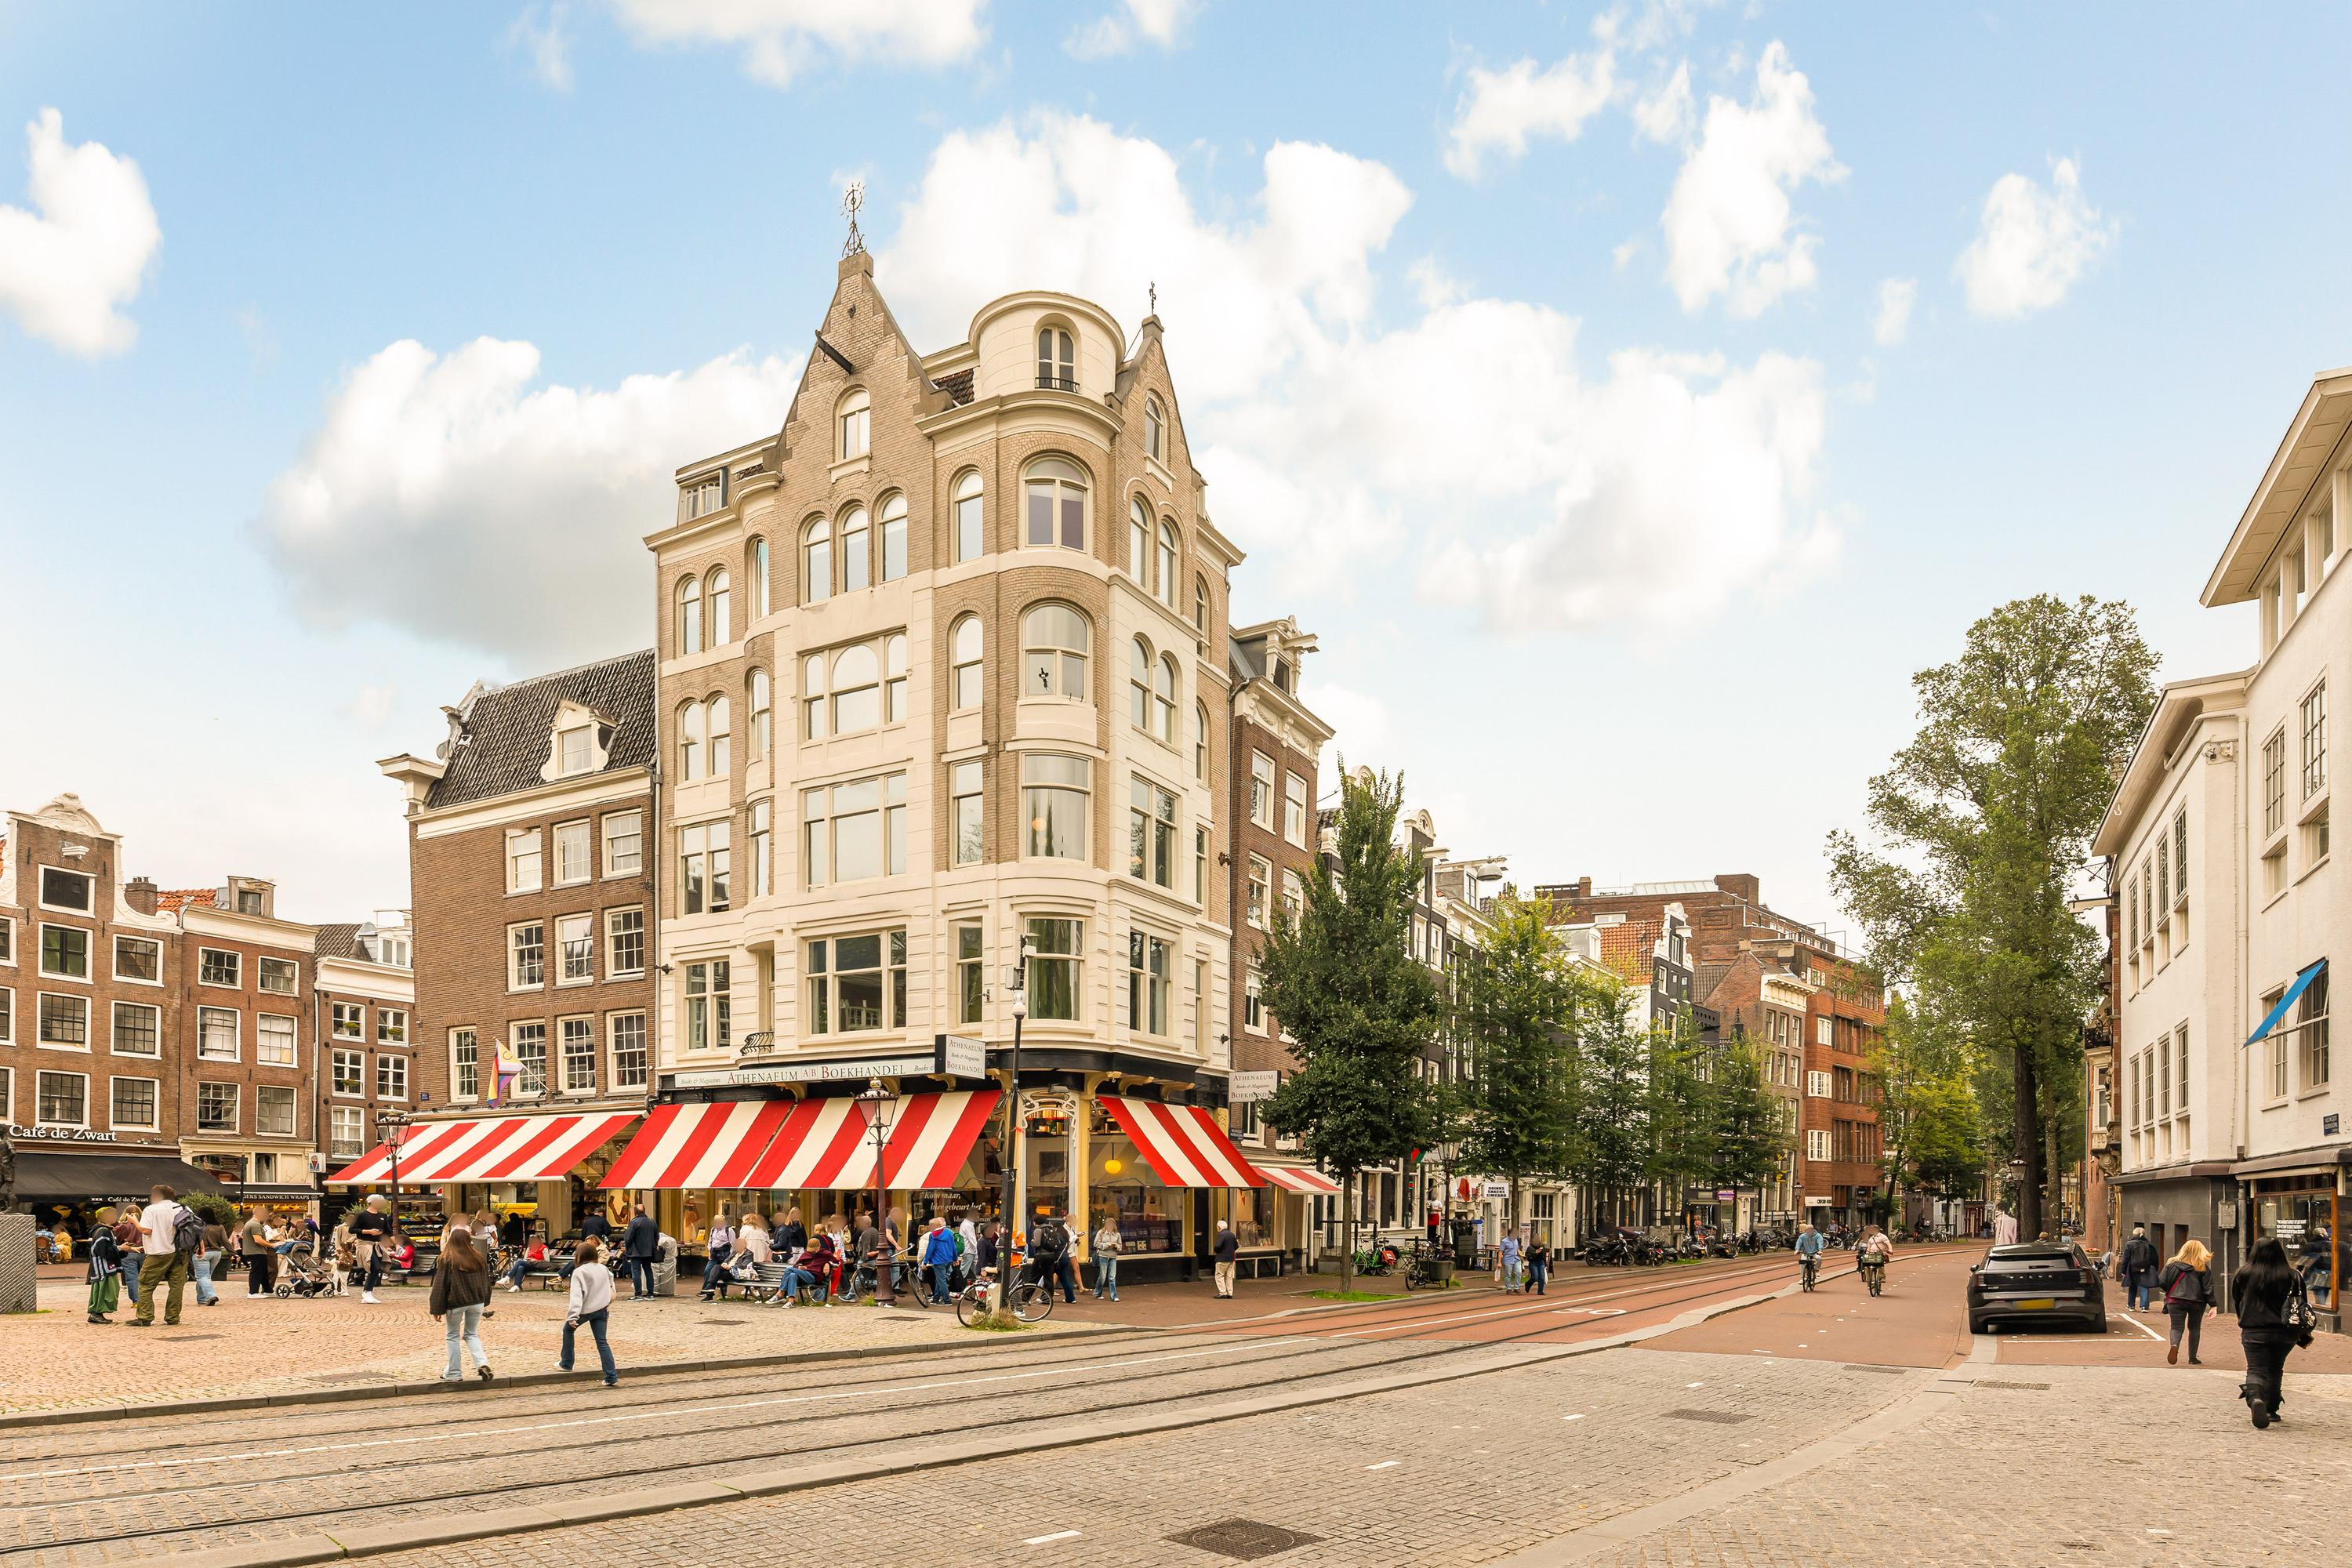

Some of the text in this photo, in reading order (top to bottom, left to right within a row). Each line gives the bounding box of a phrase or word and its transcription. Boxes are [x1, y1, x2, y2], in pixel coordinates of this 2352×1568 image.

[949, 1039, 983, 1052] ATHENAEUM
[947, 1061, 983, 1073] BOEKHANDEL
[728, 1071, 798, 1083] ATHENAEUM
[822, 1065, 906, 1079] BOEKHANDEL
[9, 1125, 117, 1141] Café de Zwart
[944, 1202, 970, 1213] gebeurt
